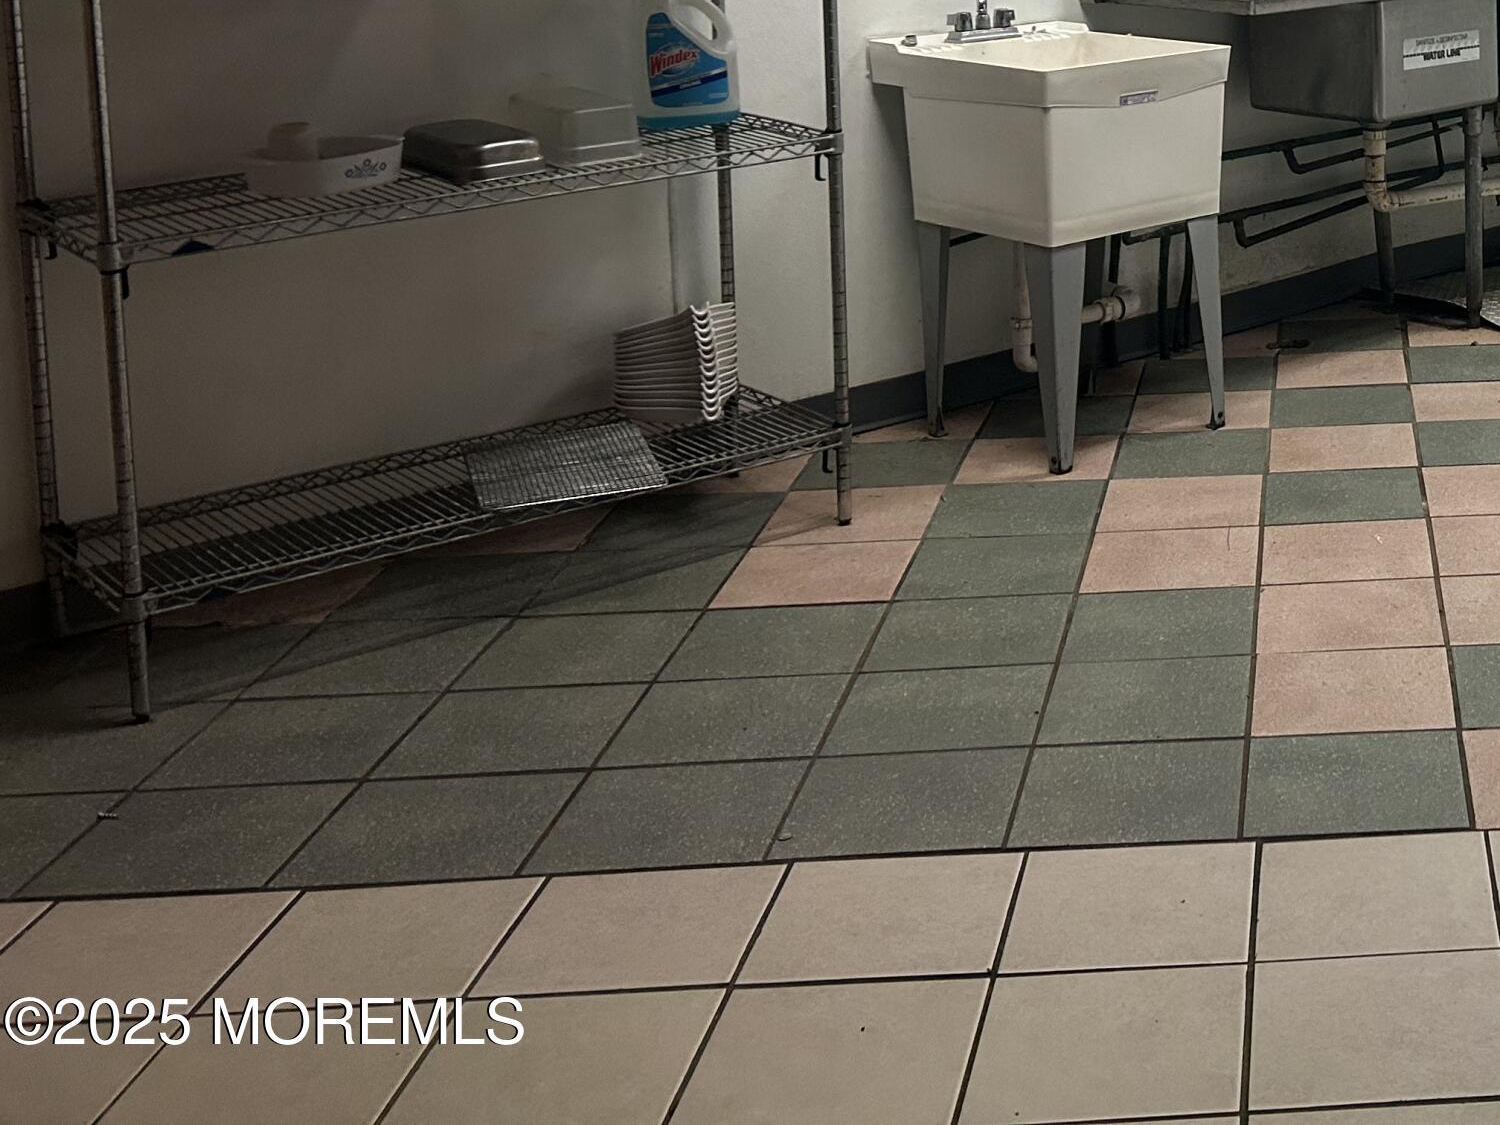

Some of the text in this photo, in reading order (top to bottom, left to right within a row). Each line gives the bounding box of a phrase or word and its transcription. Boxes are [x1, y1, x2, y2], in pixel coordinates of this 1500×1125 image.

[649, 48, 700, 78] Windex
[1423, 47, 1461, 61] WATER LINE
